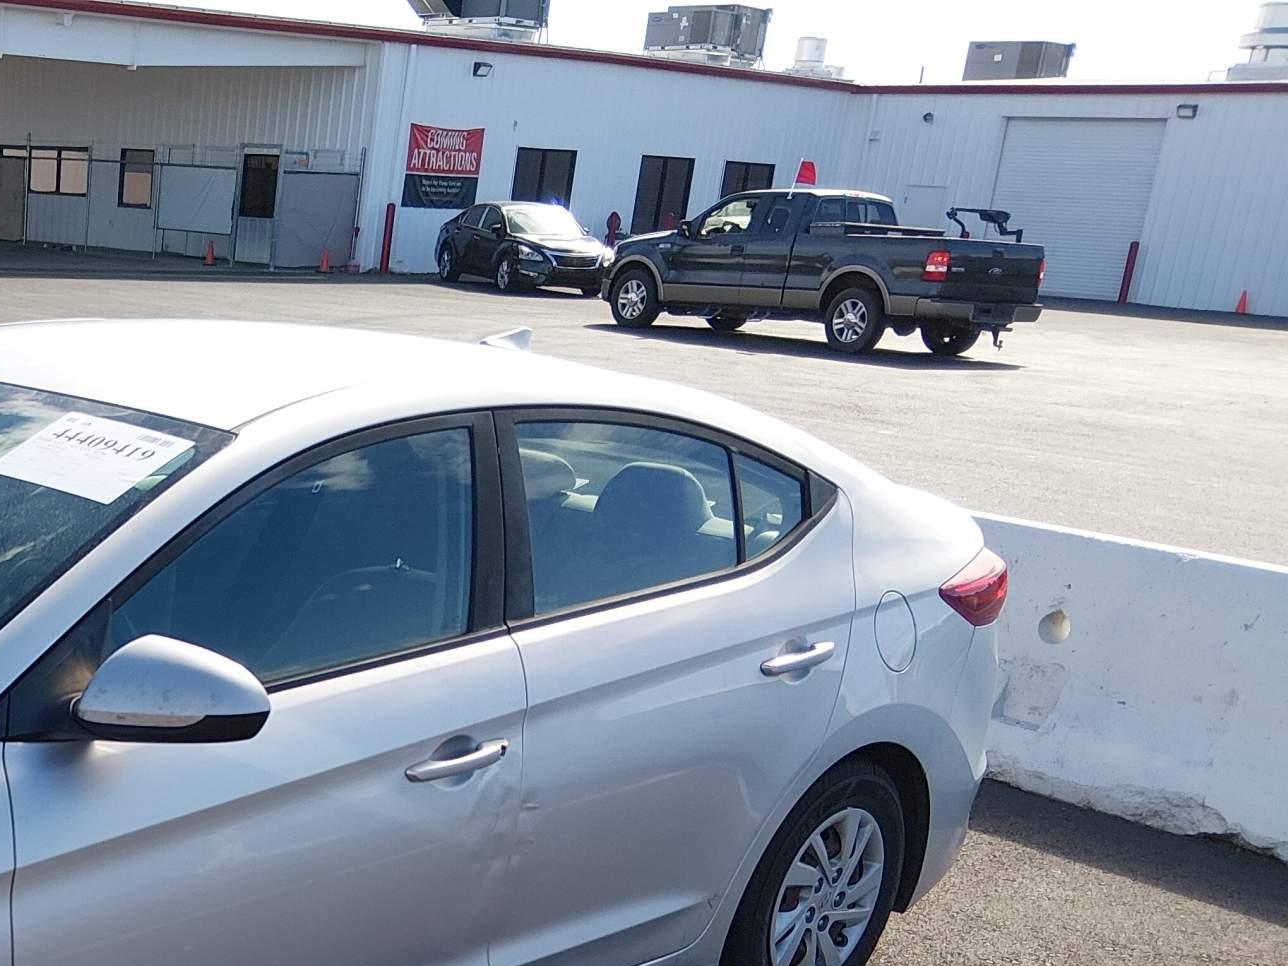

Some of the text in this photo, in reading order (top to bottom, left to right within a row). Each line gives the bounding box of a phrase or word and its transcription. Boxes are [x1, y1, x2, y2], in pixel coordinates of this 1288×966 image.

[427, 129, 467, 150] COMING
[410, 148, 477, 171] ATTRACTIONS
[53, 428, 156, 461] 44409419
